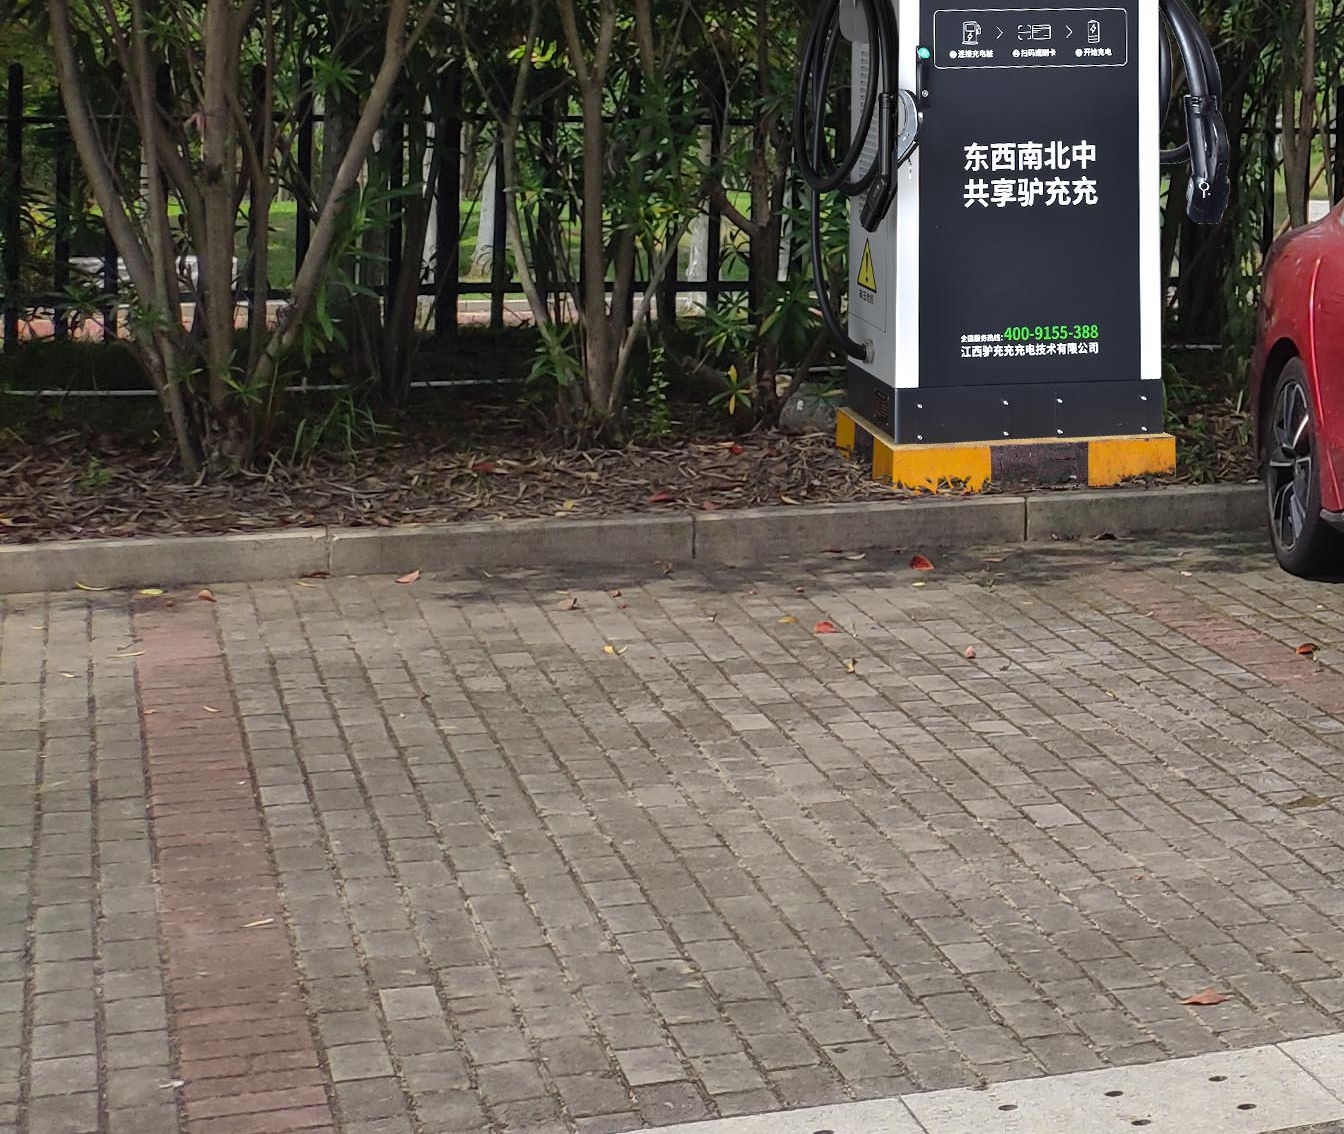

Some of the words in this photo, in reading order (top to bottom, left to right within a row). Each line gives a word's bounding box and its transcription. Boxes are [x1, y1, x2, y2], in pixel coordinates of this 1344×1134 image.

[1083, 46, 1113, 57] 开始充电
[963, 139, 1097, 172] 东西南北中
[963, 175, 1099, 209] 共享驴充充
[1003, 323, 1099, 341] 400-9155-388
[960, 341, 1099, 358] 江西驴充充充电技术有限公司
